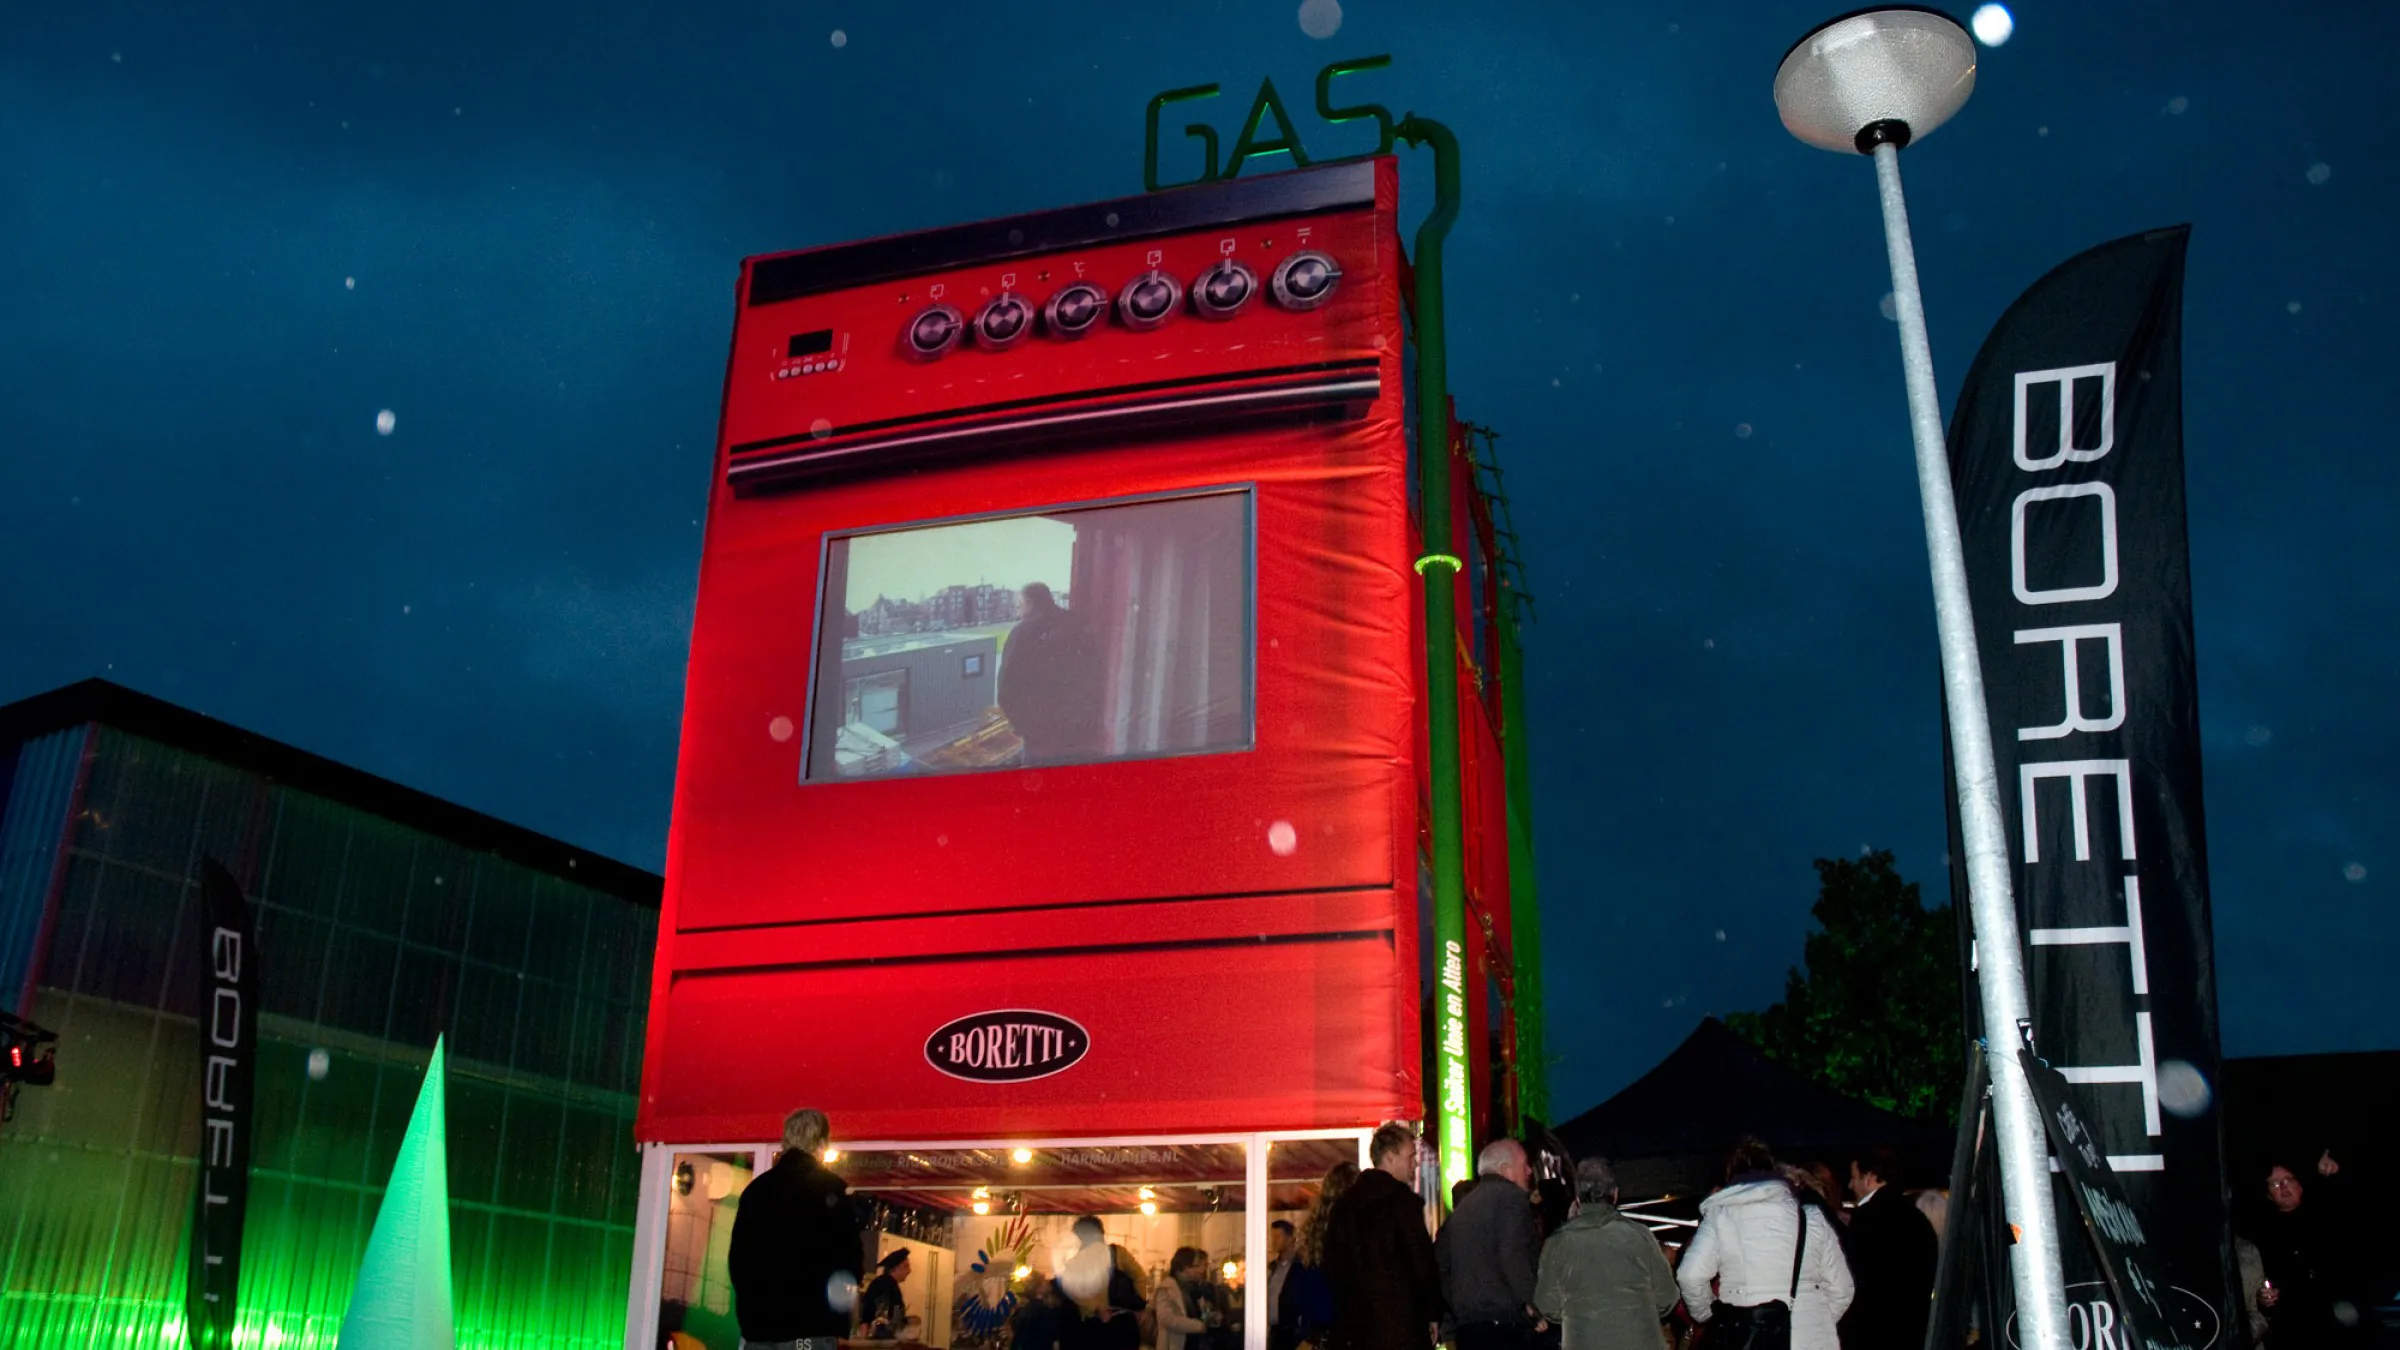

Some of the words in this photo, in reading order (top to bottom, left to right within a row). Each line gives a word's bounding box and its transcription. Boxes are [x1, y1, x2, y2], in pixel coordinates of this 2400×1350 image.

[1144, 54, 1393, 192] GAS
[2012, 361, 2165, 1172] BORETTI
[1442, 940, 1462, 994] Attero
[1447, 993, 1463, 1017] en
[949, 1023, 1065, 1069] BORETTI
[1443, 1017, 1463, 1057] Unie
[1444, 1056, 1465, 1117] Suiker
